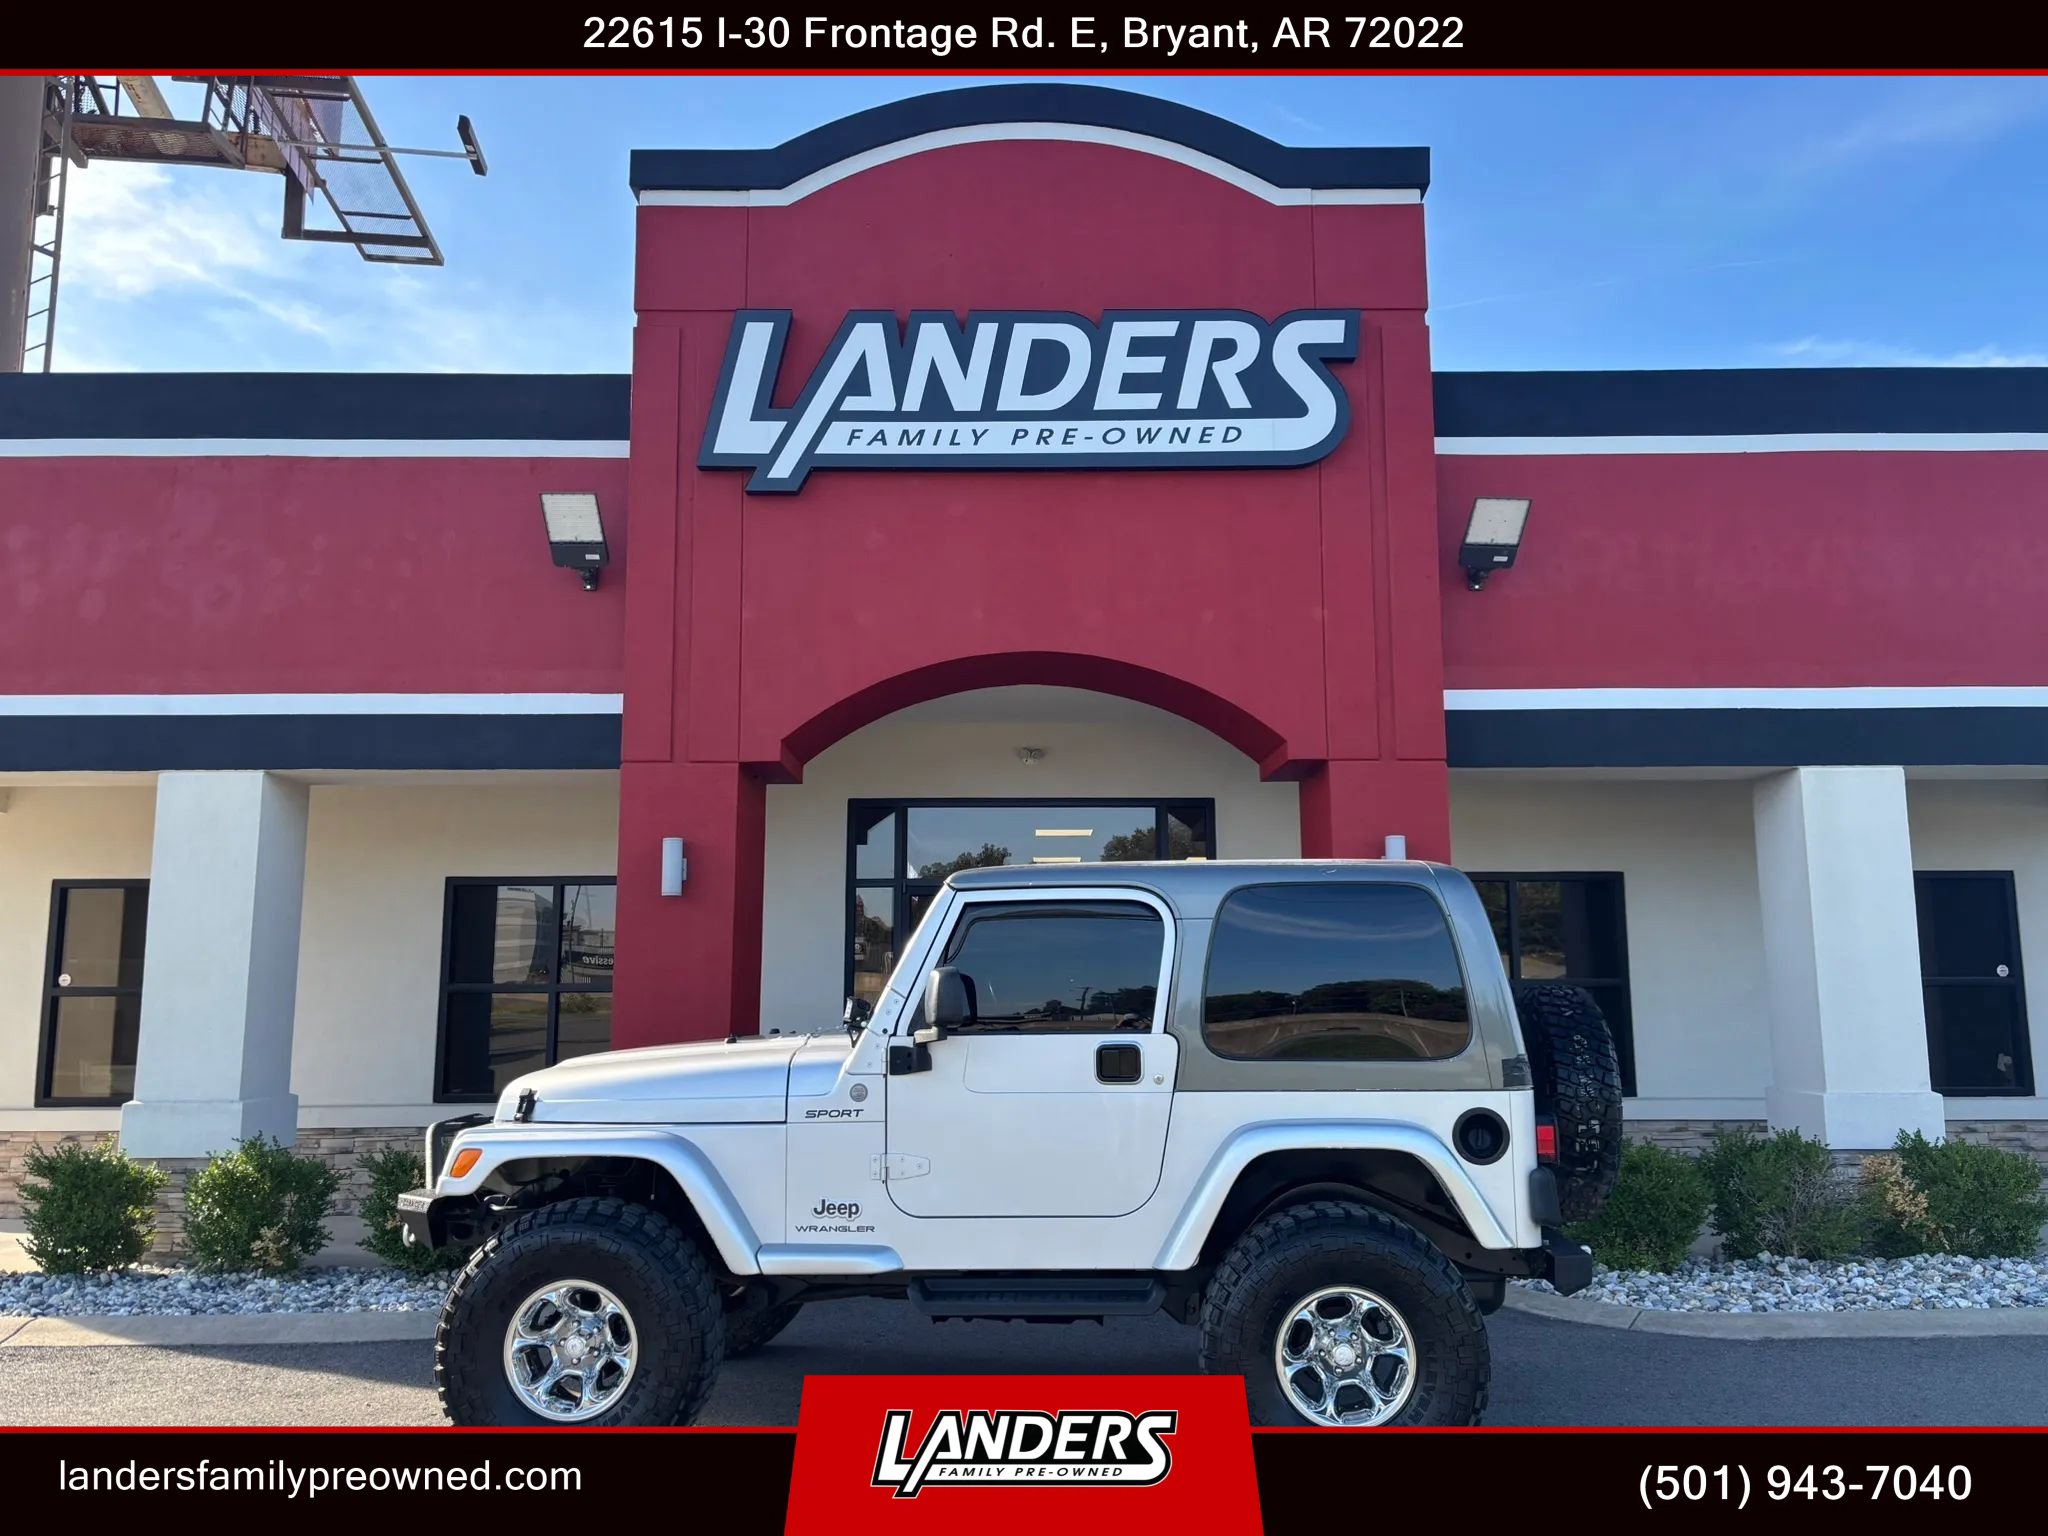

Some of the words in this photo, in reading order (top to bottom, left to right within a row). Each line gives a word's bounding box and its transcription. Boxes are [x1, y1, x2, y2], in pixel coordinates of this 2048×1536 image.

[713, 319, 1346, 478] LANDERS
[847, 426, 991, 447] FAMILY
[1011, 425, 1244, 446] PRE-OWNED
[804, 1109, 865, 1119] SPORT
[813, 1198, 860, 1219] Jeep
[795, 1225, 875, 1233] WRANGLER
